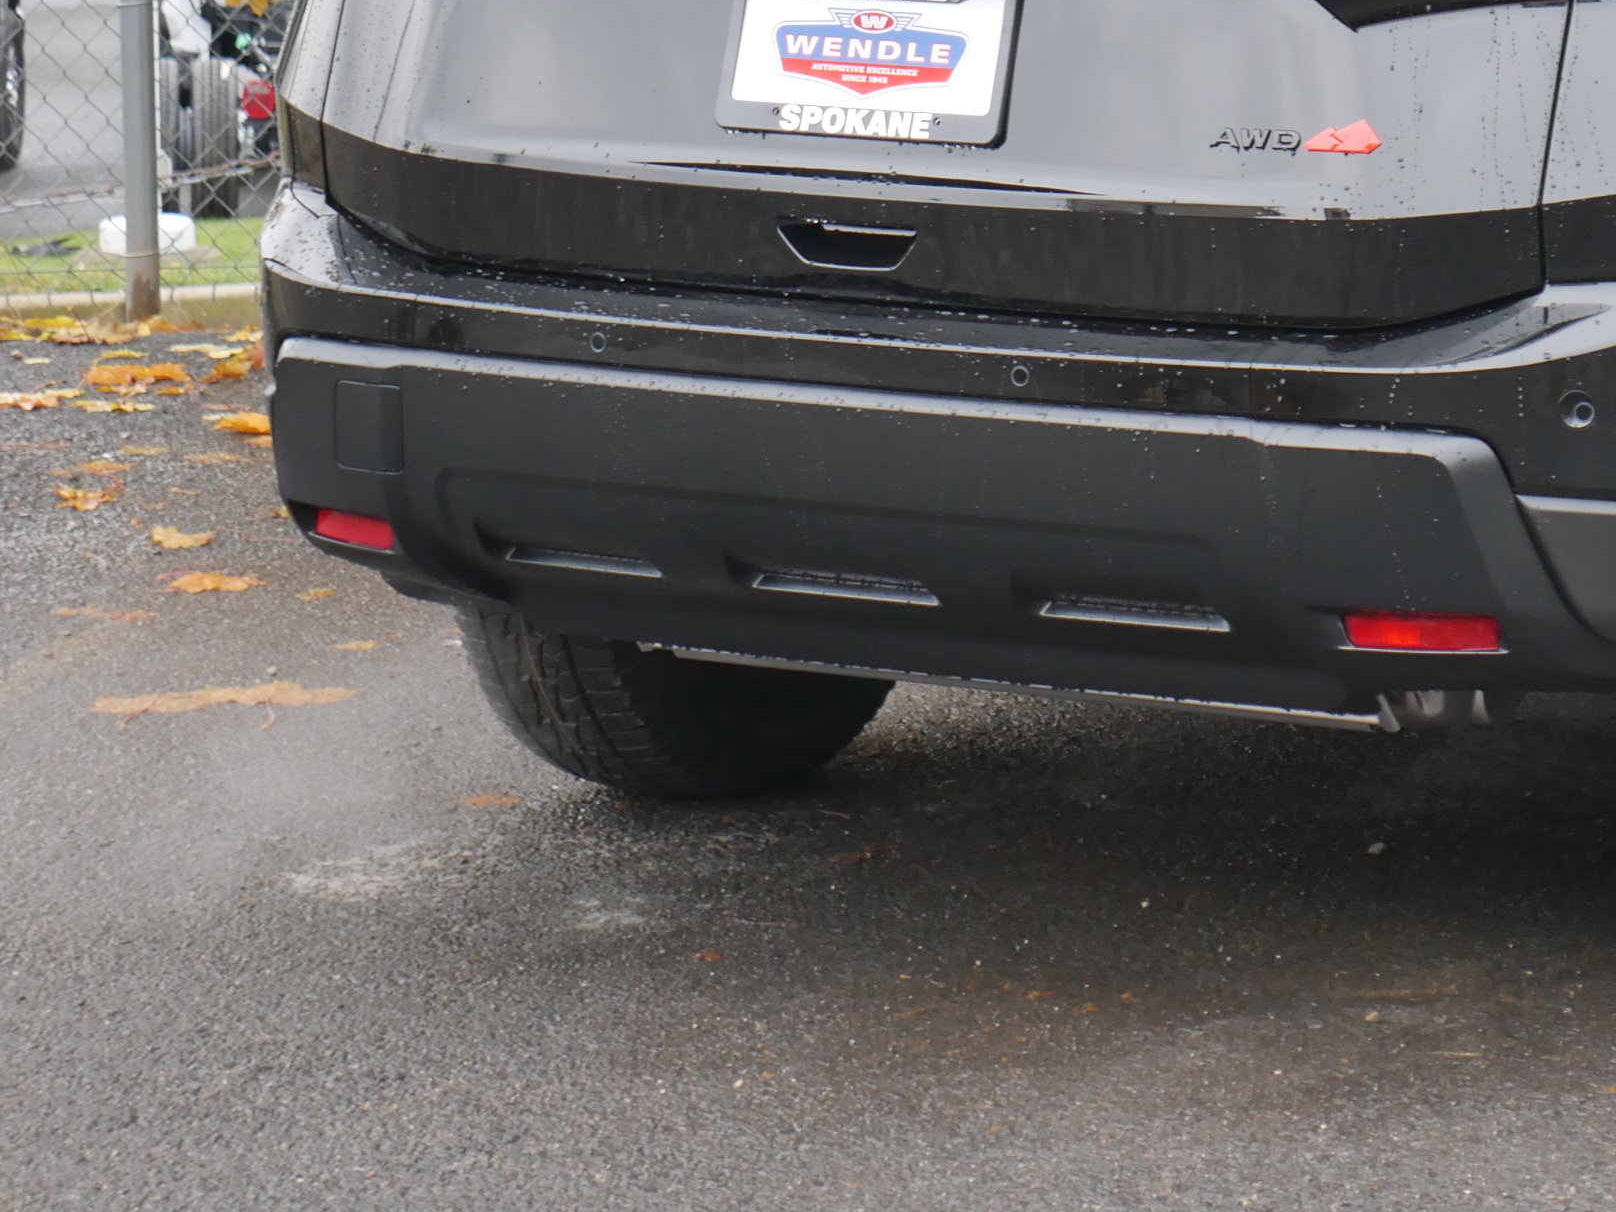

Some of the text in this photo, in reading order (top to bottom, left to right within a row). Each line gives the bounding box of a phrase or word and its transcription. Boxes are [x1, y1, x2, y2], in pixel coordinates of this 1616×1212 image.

[860, 14, 888, 30] W
[785, 34, 951, 64] WENDLE
[811, 63, 919, 76] AUTOMOTIVE EXCELLENCE
[841, 74, 867, 83] SINCE
[779, 103, 933, 139] SPOKANE
[1209, 126, 1302, 155] AWD
